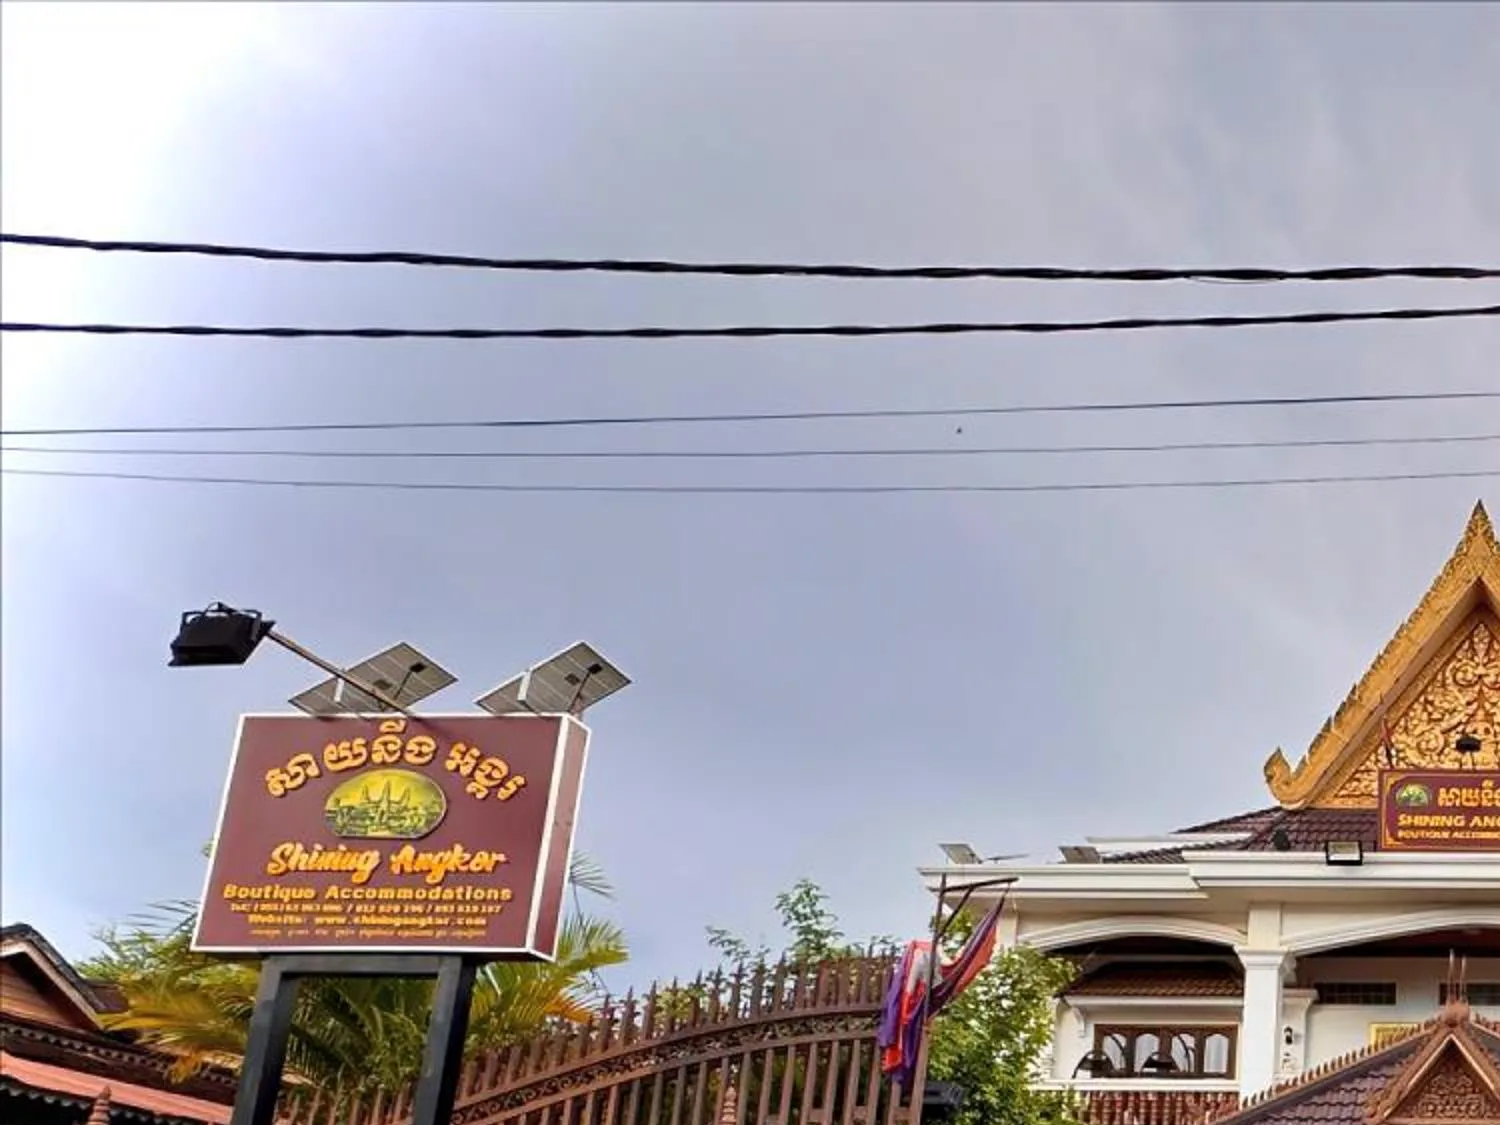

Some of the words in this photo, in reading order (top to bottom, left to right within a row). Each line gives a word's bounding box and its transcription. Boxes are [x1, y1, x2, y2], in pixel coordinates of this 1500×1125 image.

[1397, 813, 1465, 828] SHINING
[266, 840, 383, 885] Shining
[389, 843, 506, 885] Angkor
[223, 884, 317, 903] Boutique
[324, 884, 514, 901] Accommodations
